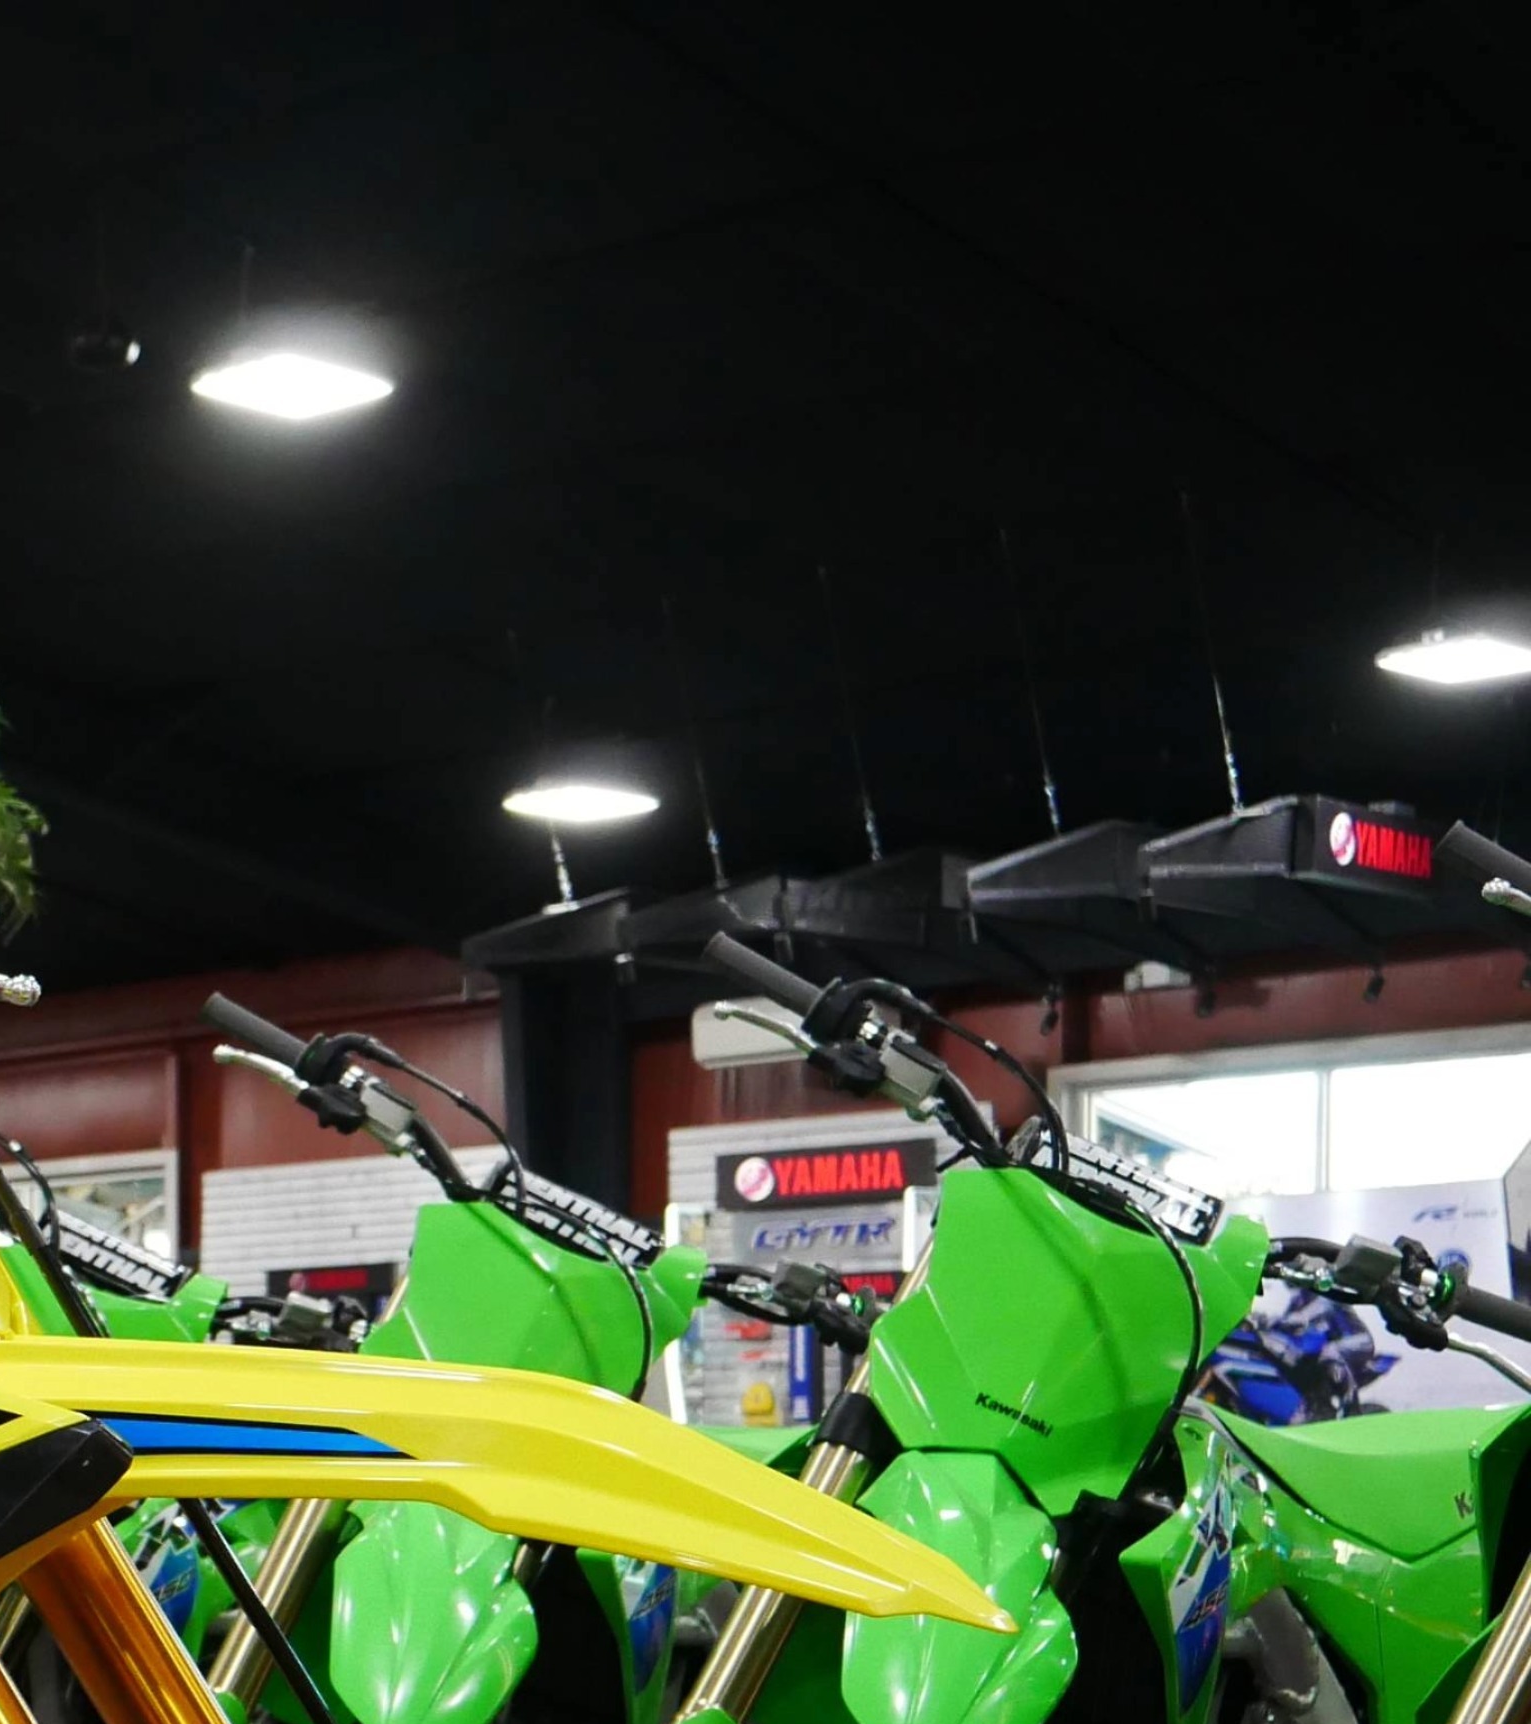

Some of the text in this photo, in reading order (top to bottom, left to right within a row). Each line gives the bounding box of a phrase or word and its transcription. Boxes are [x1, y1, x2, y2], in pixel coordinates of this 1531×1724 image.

[1355, 819, 1432, 879] YAMAHA
[772, 1149, 904, 1197] YAMAHA
[974, 1391, 1054, 1439] Kawasaki
